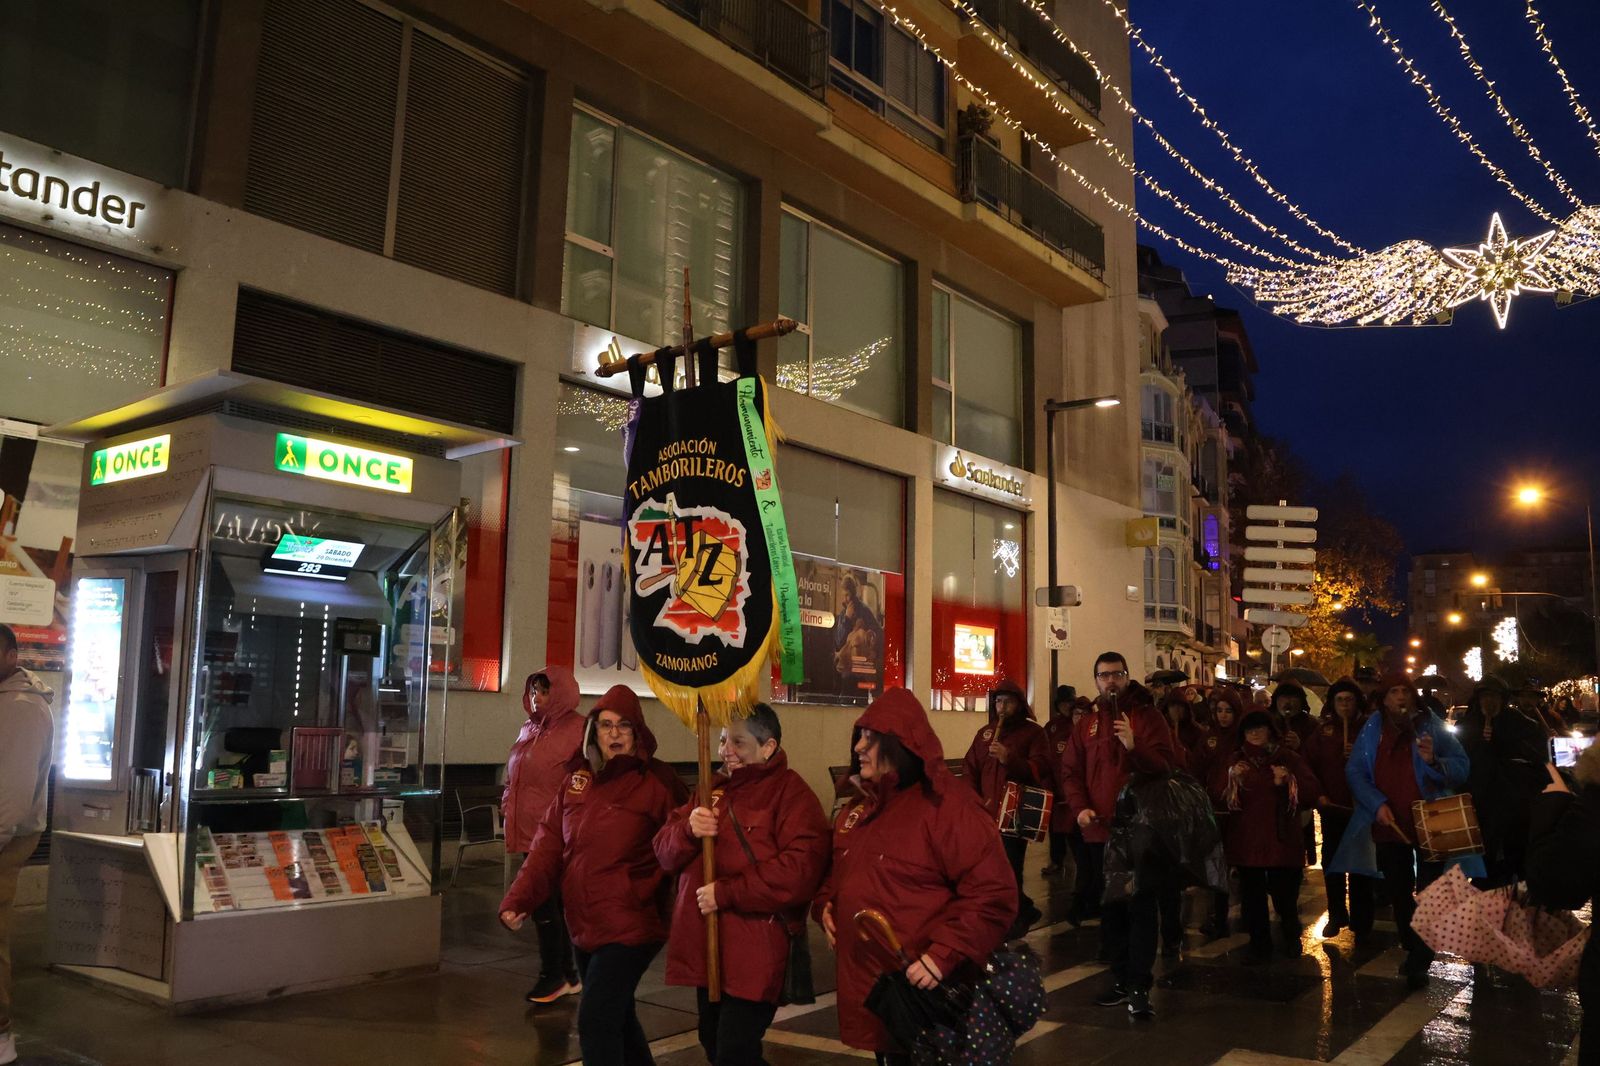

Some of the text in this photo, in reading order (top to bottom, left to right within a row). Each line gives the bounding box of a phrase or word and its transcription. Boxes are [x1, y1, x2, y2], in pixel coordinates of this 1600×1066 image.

[112, 442, 163, 474] ONCE
[658, 437, 717, 463] ASOCIACIÓN
[318, 448, 402, 485] ONCE
[628, 457, 747, 500] TAMBORILEROS
[966, 461, 1025, 497] Santander
[297, 563, 322, 574] 283
[798, 577, 822, 593] Ahora
[655, 652, 718, 673] ZAMORANOS
